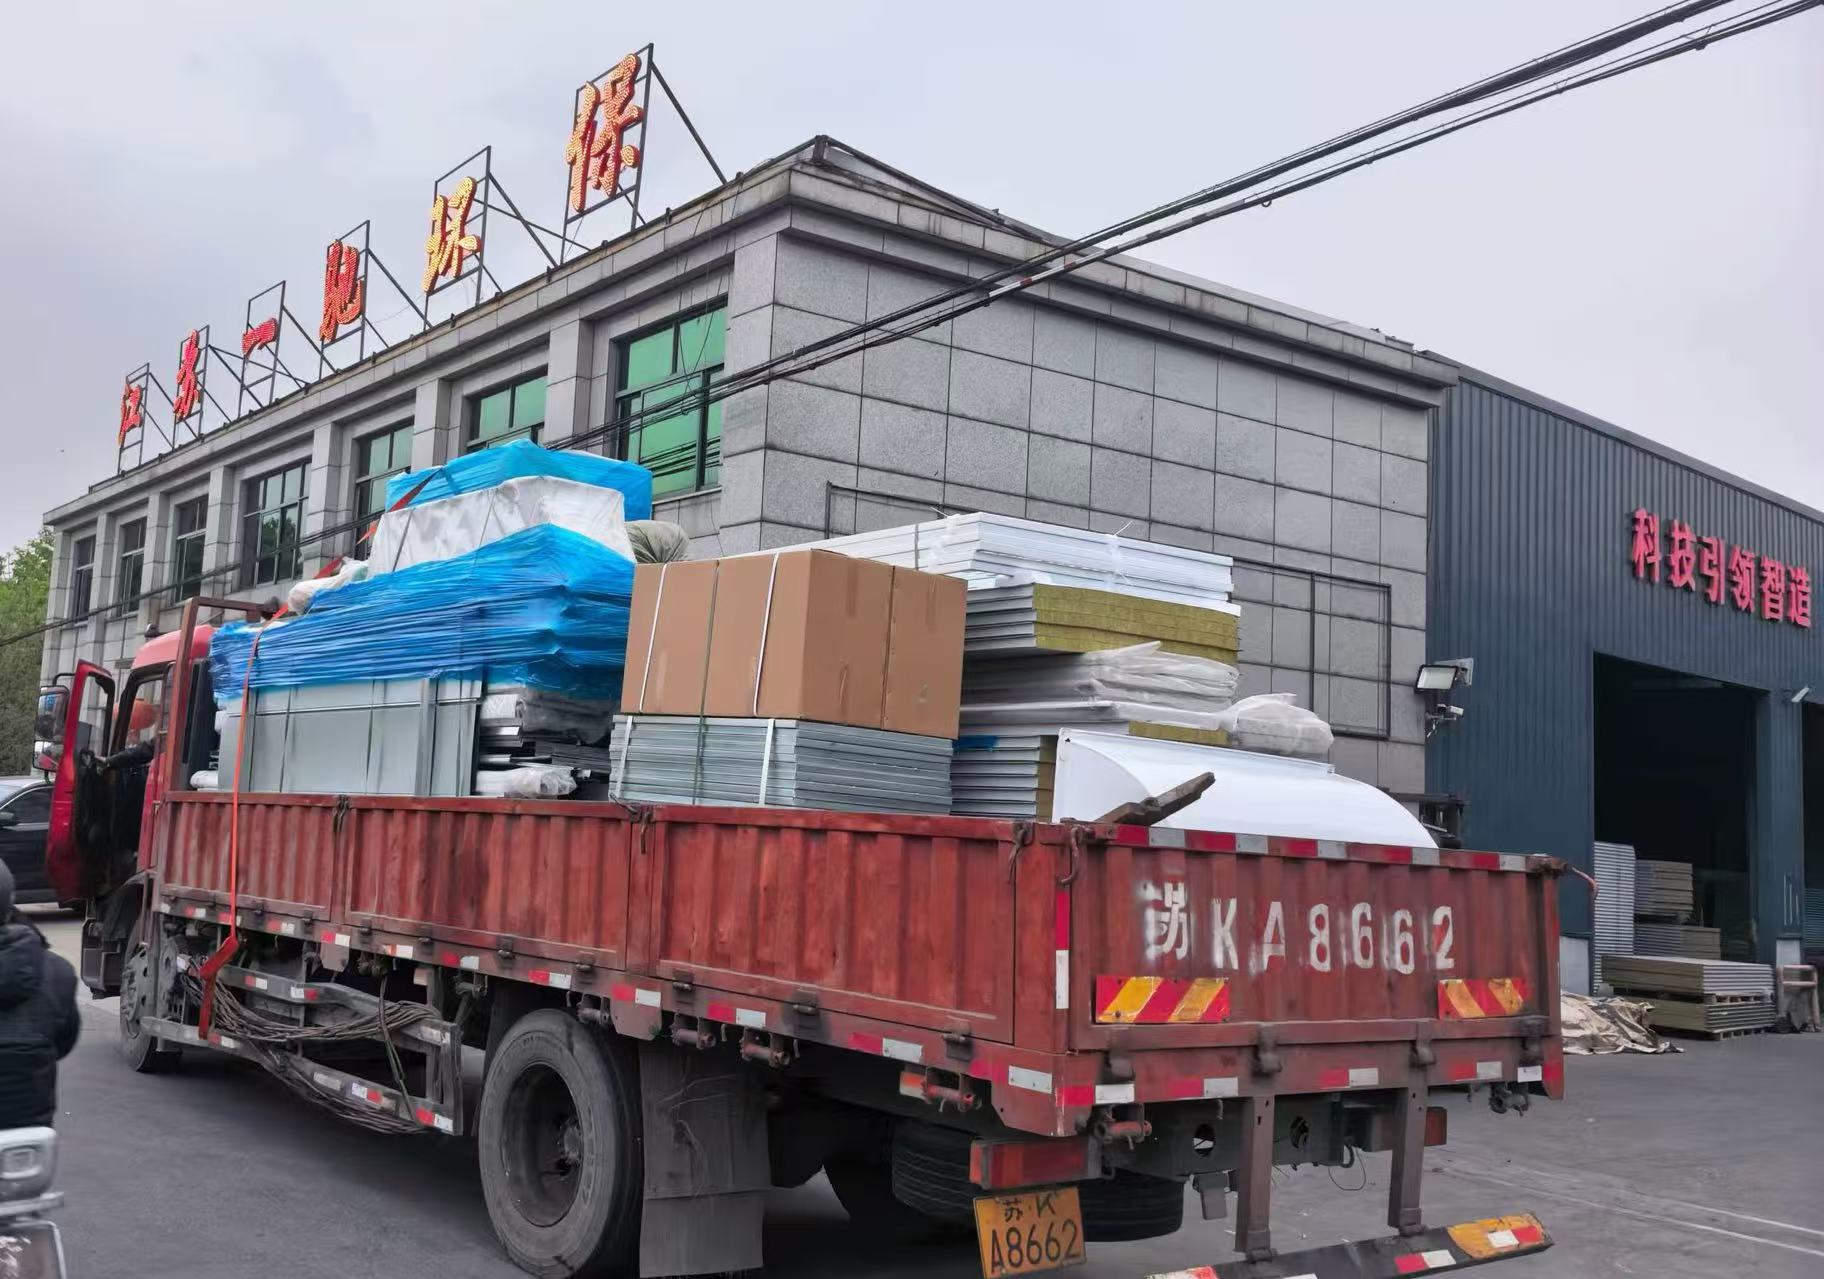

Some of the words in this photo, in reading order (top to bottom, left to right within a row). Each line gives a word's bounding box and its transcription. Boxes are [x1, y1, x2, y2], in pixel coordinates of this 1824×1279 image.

[1631, 506, 1812, 628] 科技引领智造
[990, 1218, 1081, 1275] A8662
